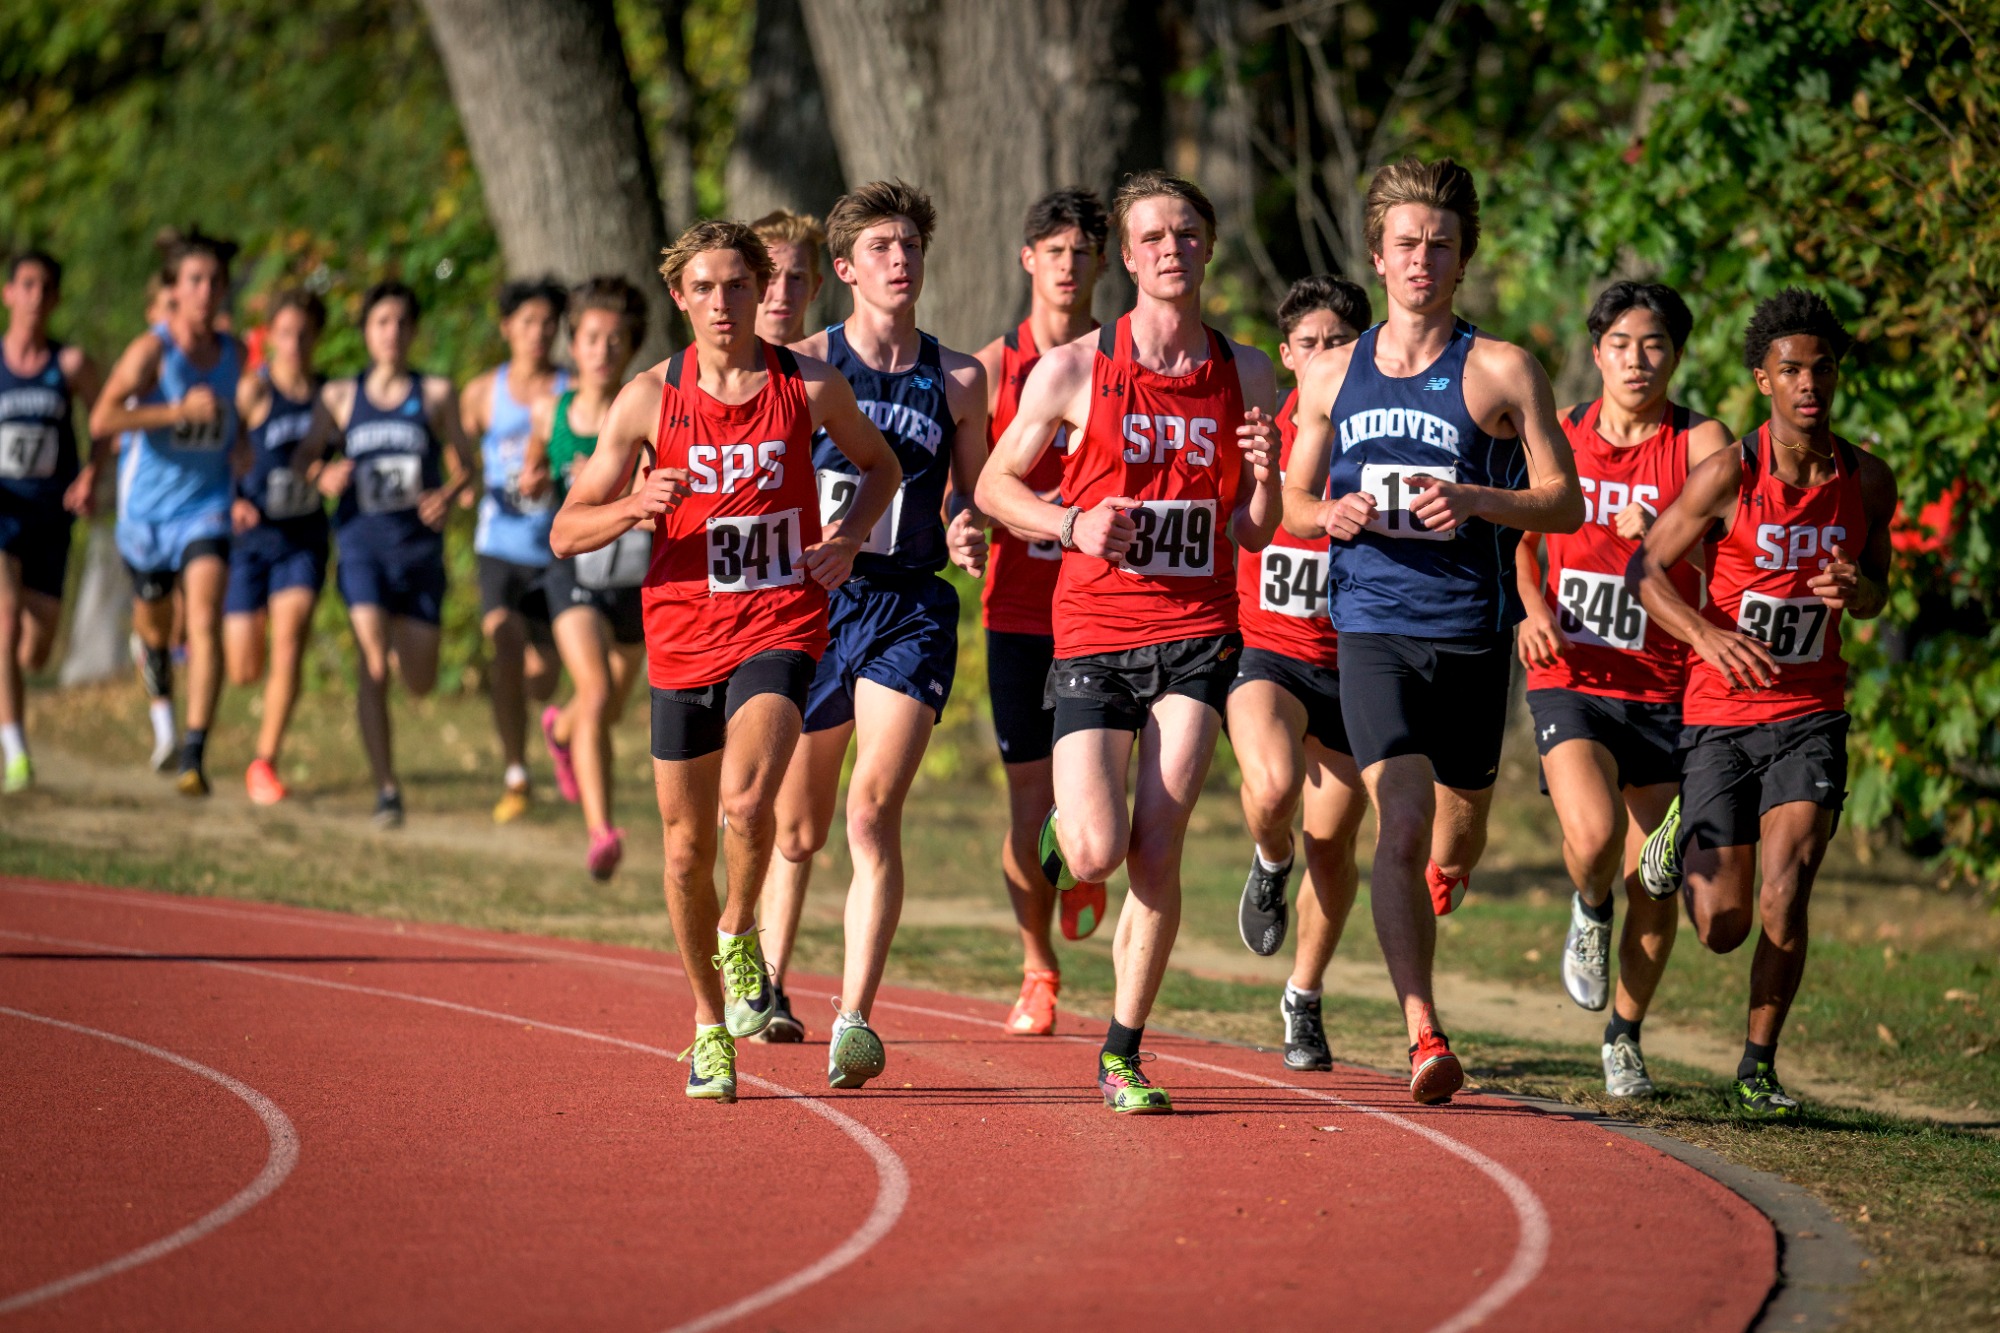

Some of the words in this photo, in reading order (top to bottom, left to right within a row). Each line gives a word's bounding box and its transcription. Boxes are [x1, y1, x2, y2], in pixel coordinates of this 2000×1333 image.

[818, 400, 943, 457] DOVER
[1122, 413, 1218, 468] SPS
[1339, 408, 1461, 457] ANDOVER
[688, 440, 786, 494] SPS
[712, 517, 793, 584] 341
[1124, 507, 1212, 568] 349
[1754, 523, 1846, 571] SPS
[1560, 577, 1641, 641] 346
[1742, 600, 1828, 657] 367
